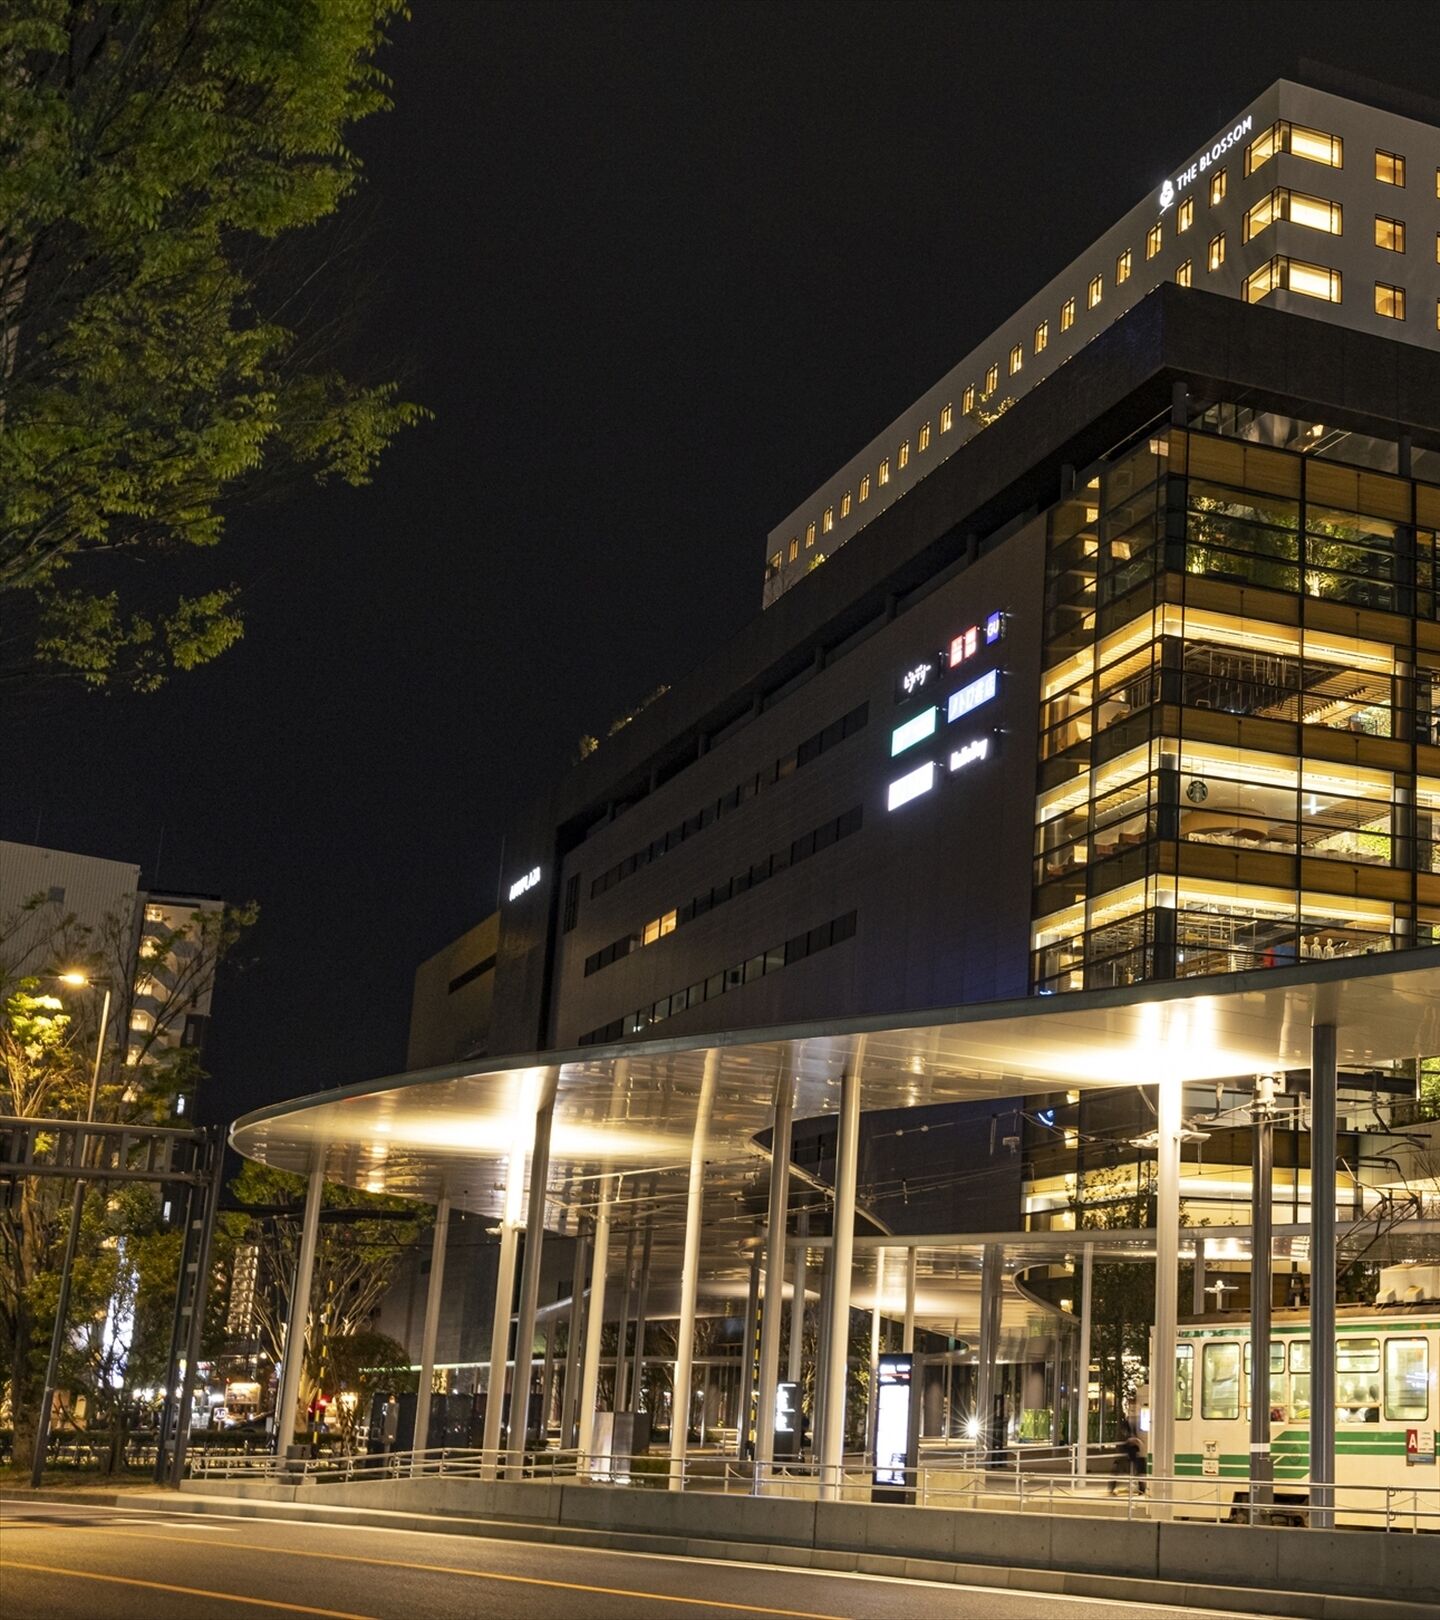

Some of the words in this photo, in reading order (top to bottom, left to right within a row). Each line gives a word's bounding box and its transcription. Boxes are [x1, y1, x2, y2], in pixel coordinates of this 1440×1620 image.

[1176, 163, 1198, 191] THE
[1199, 115, 1253, 172] BLOSSOM
[987, 619, 1000, 637] GU
